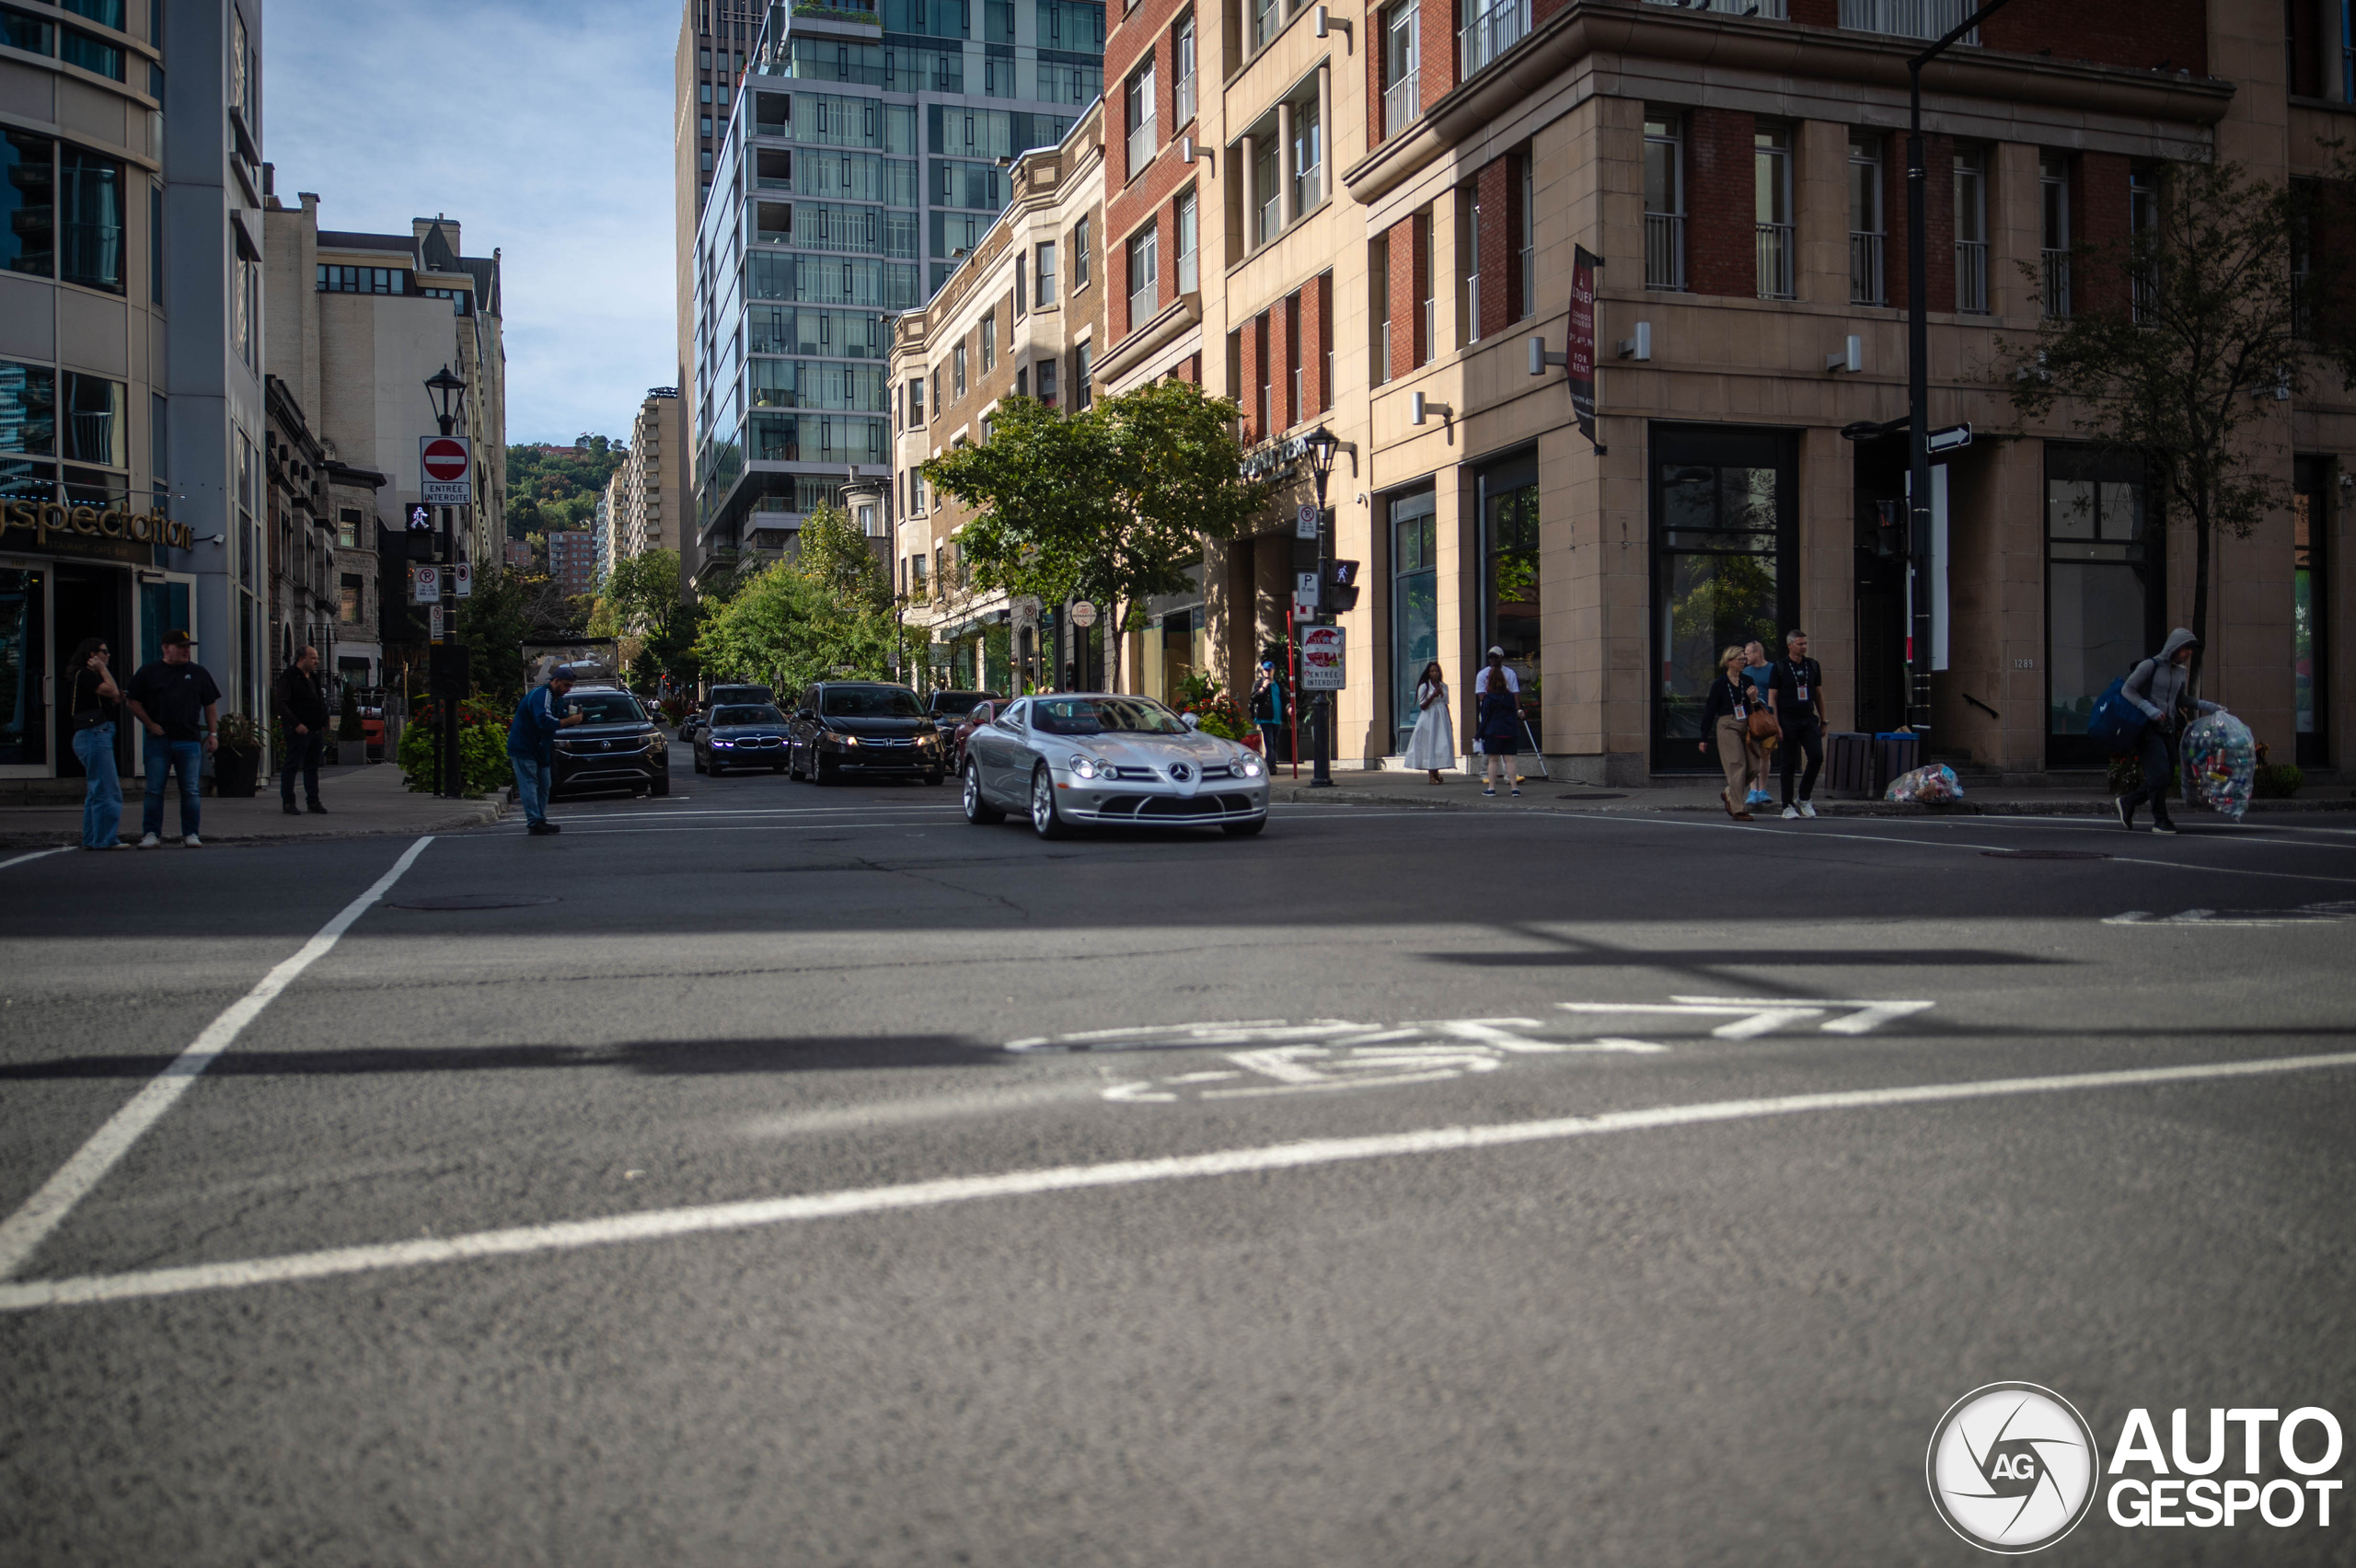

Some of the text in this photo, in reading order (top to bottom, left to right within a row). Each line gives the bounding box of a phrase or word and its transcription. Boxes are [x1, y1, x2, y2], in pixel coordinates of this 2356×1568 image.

[1572, 285, 1593, 305] LOUER
[1574, 352, 1588, 363] FOR
[1573, 362, 1589, 374] RENT
[430, 484, 463, 493] ENTRÉE
[425, 493, 468, 502] INTERDITE
[1304, 574, 1312, 587] P
[2014, 659, 2034, 668] 1289
[1310, 670, 1338, 678] ENTRÉE
